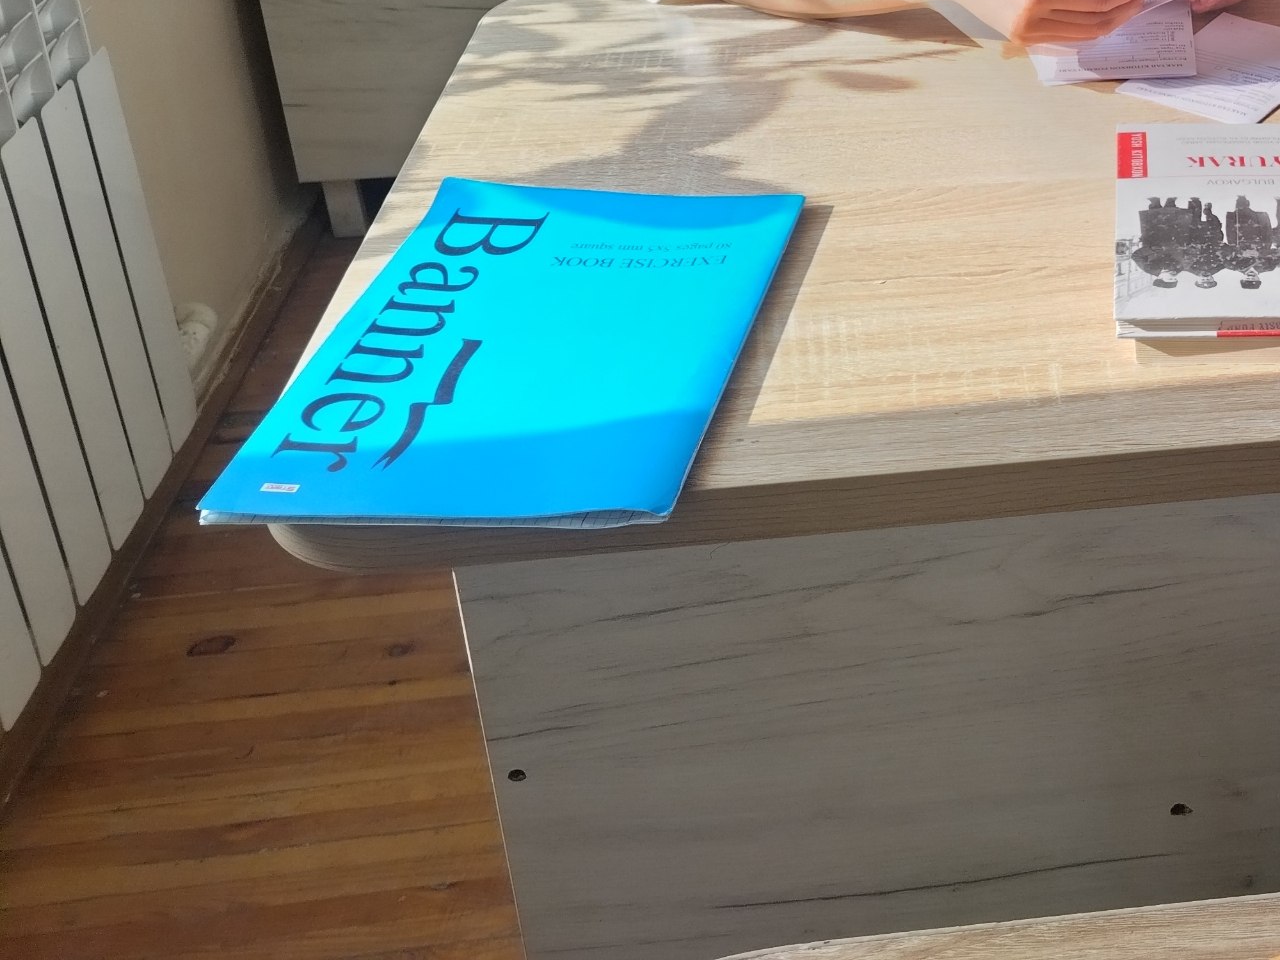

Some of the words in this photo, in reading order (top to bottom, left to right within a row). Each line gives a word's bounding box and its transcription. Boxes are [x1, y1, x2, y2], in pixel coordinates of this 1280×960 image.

[1131, 133, 1143, 148] YOSH
[1131, 149, 1143, 178] KITOBXON
[550, 256, 614, 268] BOOK
[620, 255, 728, 269] EXERCISE
[273, 208, 550, 472] Banner
